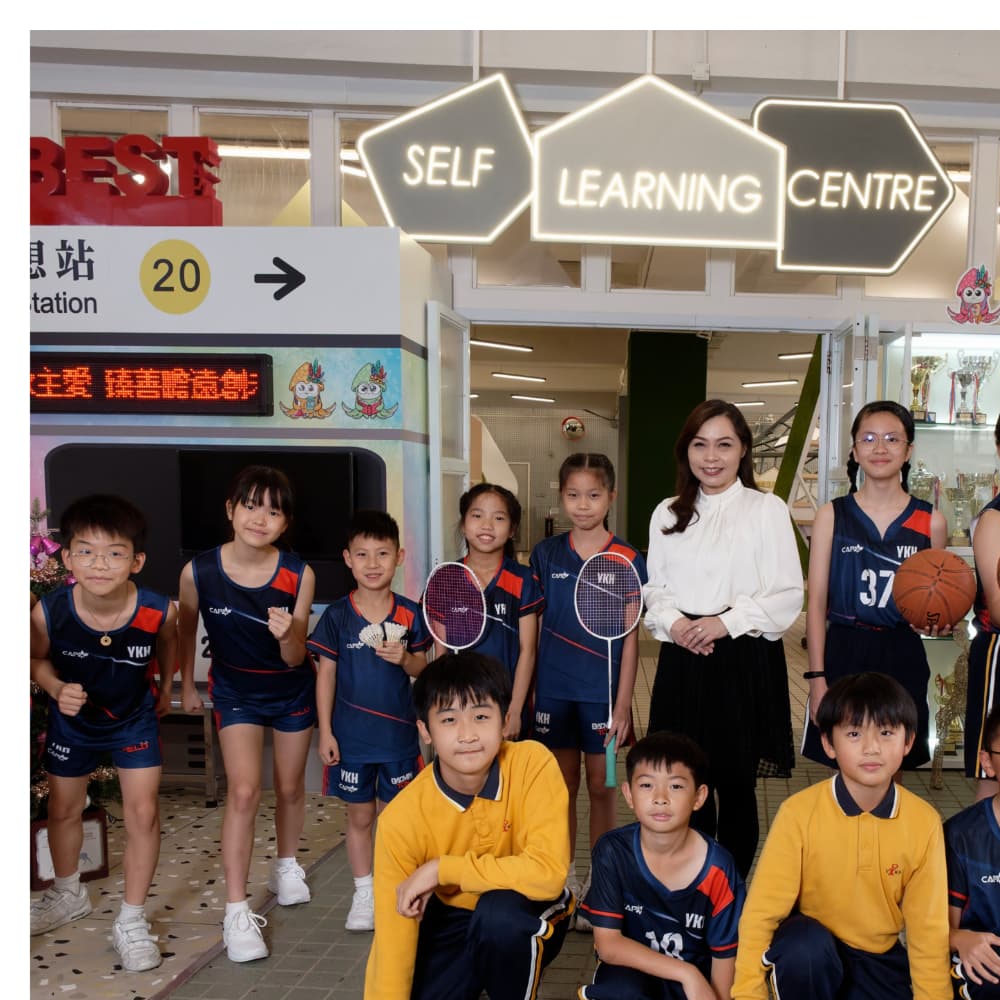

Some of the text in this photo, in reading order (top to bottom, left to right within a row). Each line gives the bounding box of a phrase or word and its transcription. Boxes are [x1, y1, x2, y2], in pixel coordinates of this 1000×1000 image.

[403, 143, 937, 215] SELF LEARNING CENTRE
[152, 257, 201, 294] 20
[30, 291, 98, 316] tation
[860, 568, 896, 609] 37
[340, 768, 359, 784] YKH
[684, 912, 706, 929] YK
